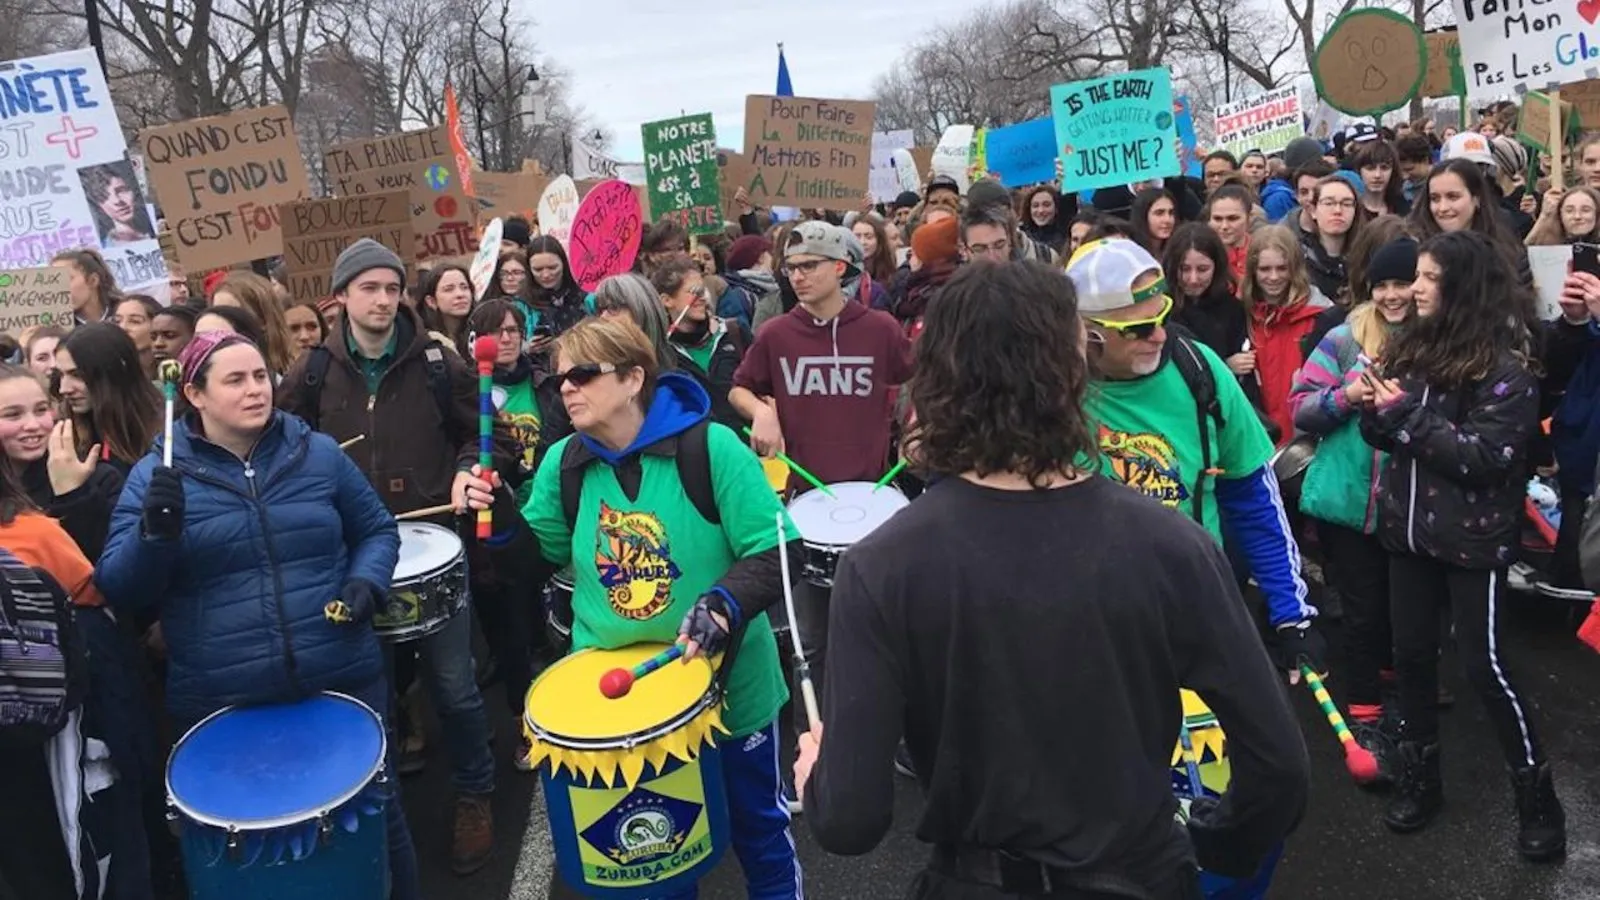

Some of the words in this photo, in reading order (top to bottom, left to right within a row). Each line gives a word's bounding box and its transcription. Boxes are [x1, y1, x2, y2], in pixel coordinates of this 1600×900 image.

[1505, 10, 1561, 38] Mon
[1473, 62, 1505, 86] Pas
[1512, 52, 1553, 79] Les
[770, 98, 811, 120] Pour
[816, 102, 857, 125] Faire
[1063, 92, 1084, 116] IS
[1085, 82, 1112, 105] THE
[1113, 79, 1154, 100] EARTH
[147, 125, 230, 164] QUAND
[234, 117, 288, 144] C'EST
[658, 121, 707, 143] NOTRE
[762, 119, 781, 141] La
[1221, 131, 1238, 143] on
[1241, 120, 1274, 137] veut
[326, 150, 361, 174] TA
[648, 139, 717, 175] PLANÈTE
[752, 144, 821, 168] Mettons
[829, 145, 857, 168] Fin
[1075, 143, 1119, 177] JUST
[185, 158, 288, 209] FONDU
[658, 175, 681, 192] est
[689, 167, 701, 189] à
[293, 197, 388, 234] BOUGEZ
[675, 191, 694, 209] SA
[177, 211, 233, 246] C'EST
[779, 356, 875, 397] VANS
[596, 843, 704, 880] ZURUBA.COM
